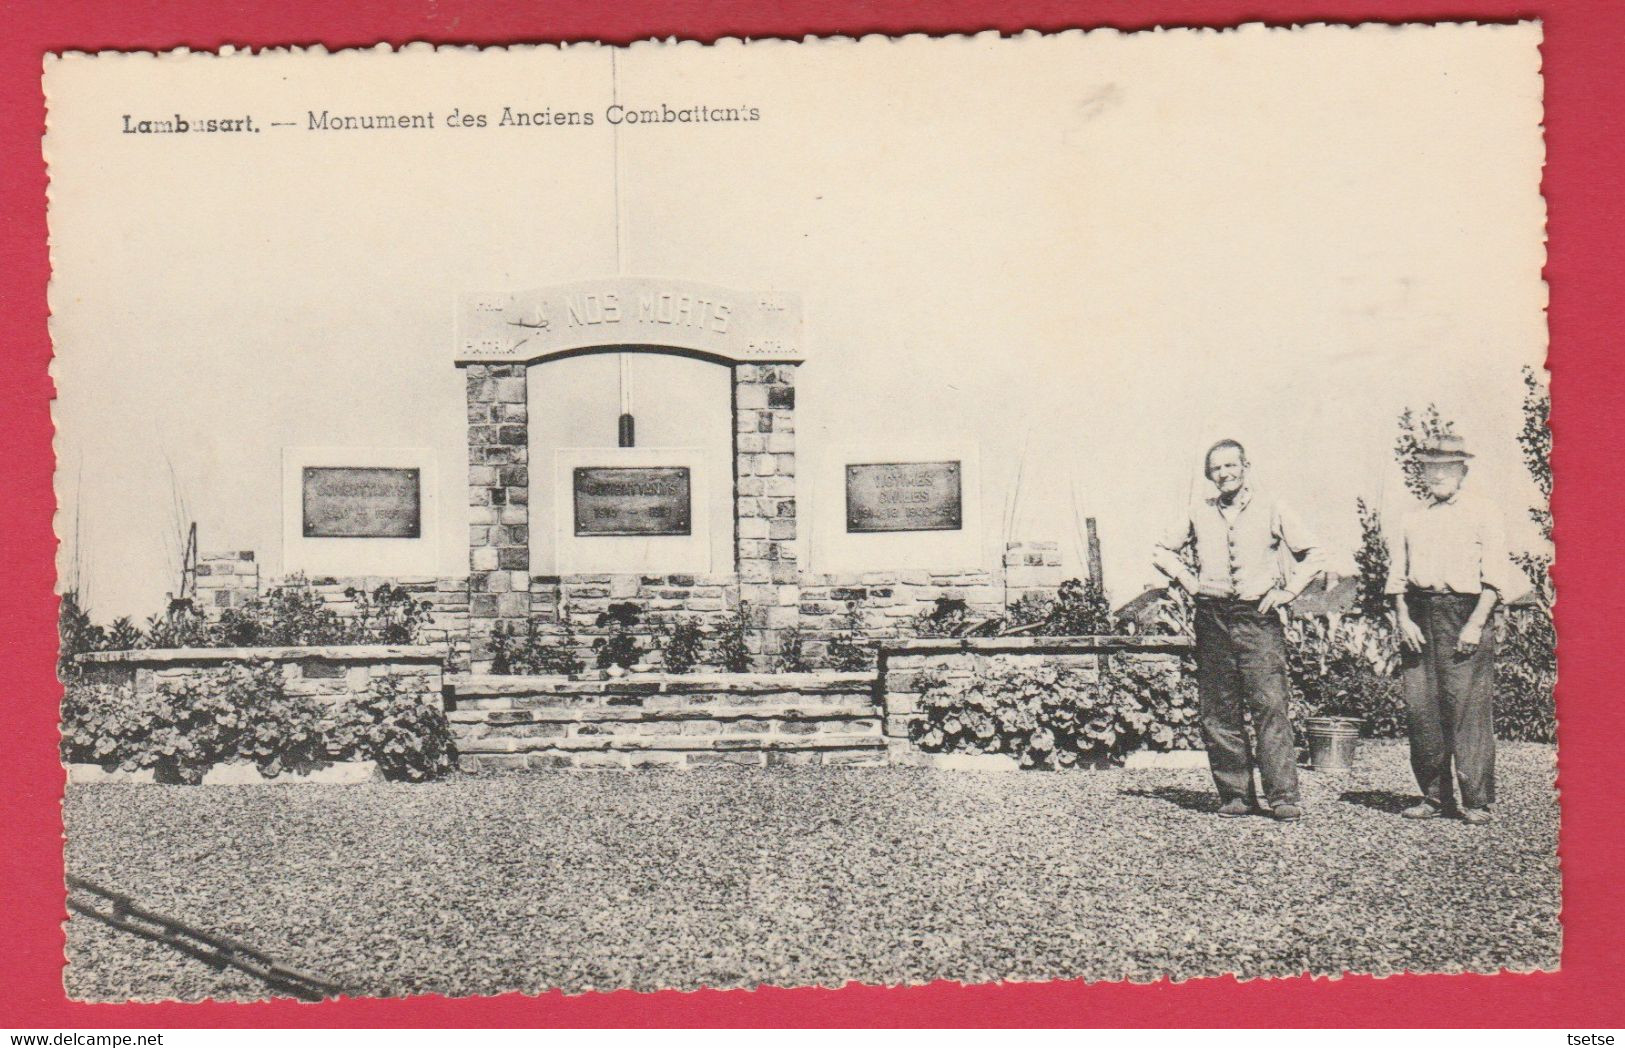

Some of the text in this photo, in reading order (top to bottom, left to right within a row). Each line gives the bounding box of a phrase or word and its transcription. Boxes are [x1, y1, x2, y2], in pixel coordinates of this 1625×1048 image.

[122, 114, 260, 133] Lambusart.
[307, 110, 435, 130] Monument
[446, 108, 488, 128] des
[498, 106, 595, 127] Anciens
[606, 103, 761, 125] Combattants
[565, 292, 622, 328] NOS
[637, 293, 733, 336] MORTS
